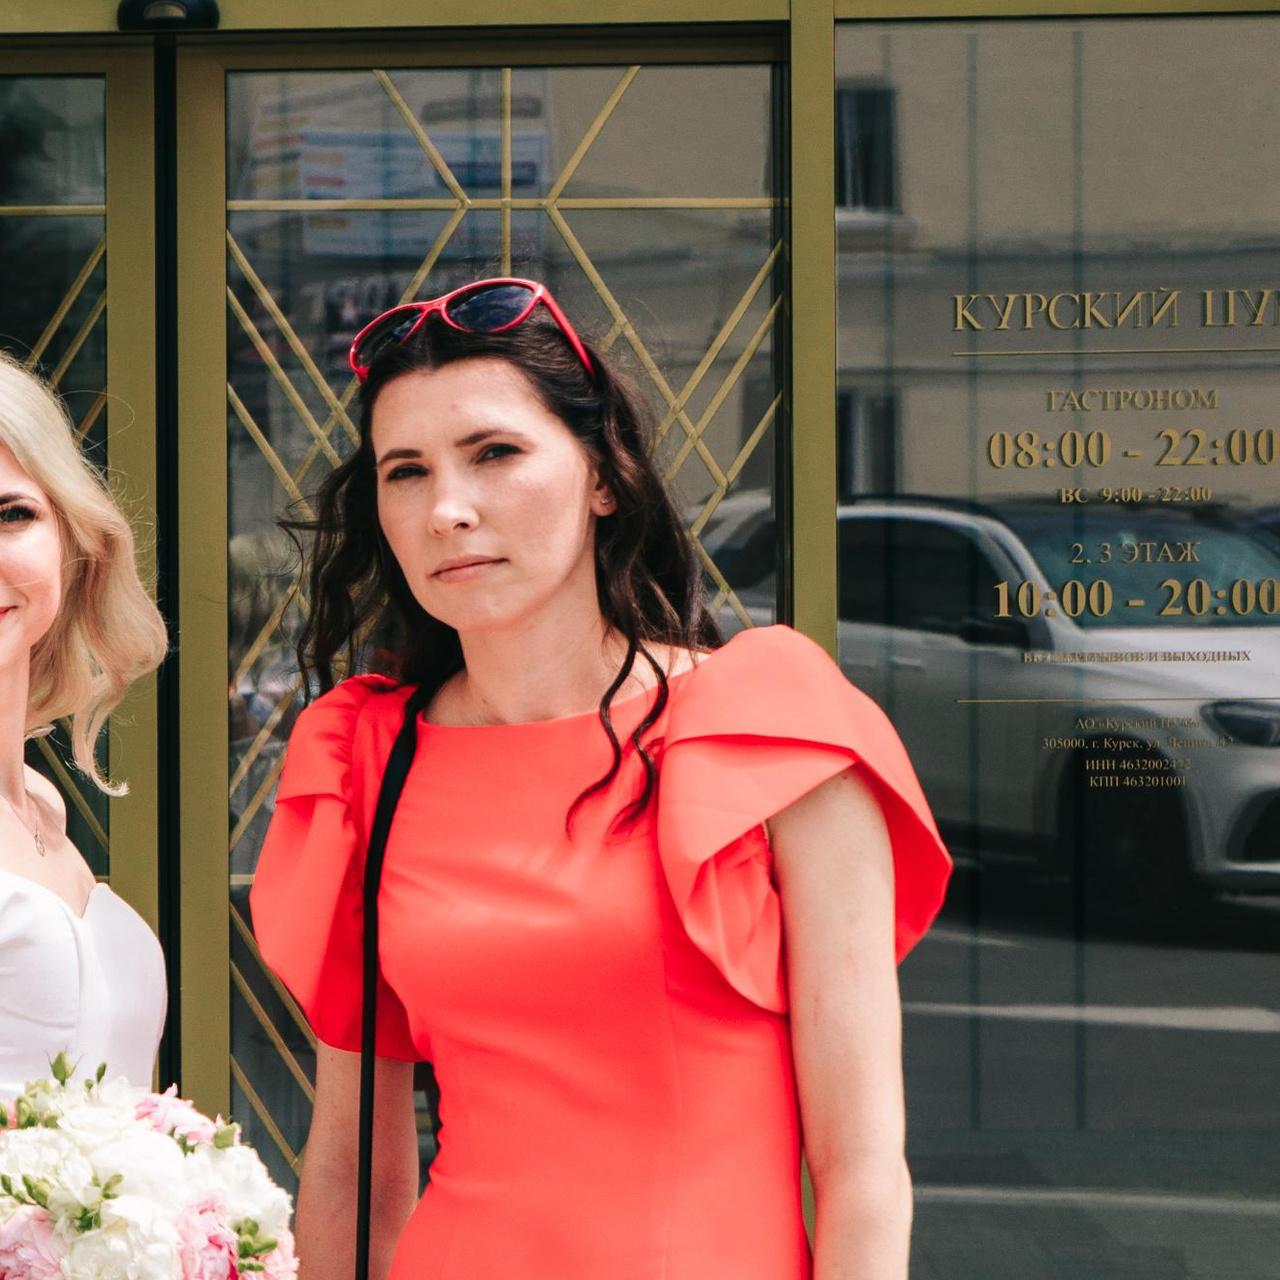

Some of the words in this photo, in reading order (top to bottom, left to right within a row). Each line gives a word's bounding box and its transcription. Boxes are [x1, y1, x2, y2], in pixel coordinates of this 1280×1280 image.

[954, 287, 1181, 331] КУРСКИЙ
[1203, 289, 1280, 330] ЦУ
[1048, 389, 1219, 411] ГАСТРОНОМ
[989, 430, 1111, 468] 08:00
[1156, 428, 1280, 466] 22:00
[1061, 487, 1089, 503] ВС
[1102, 486, 1142, 502] 9:00
[1161, 486, 1213, 502] 22:00
[1099, 542, 1111, 563] 3
[1121, 541, 1201, 564] ЭТАЖ
[993, 580, 1113, 618] 10:00
[1160, 579, 1280, 616] 20:00
[1090, 776, 1119, 787] КПП
